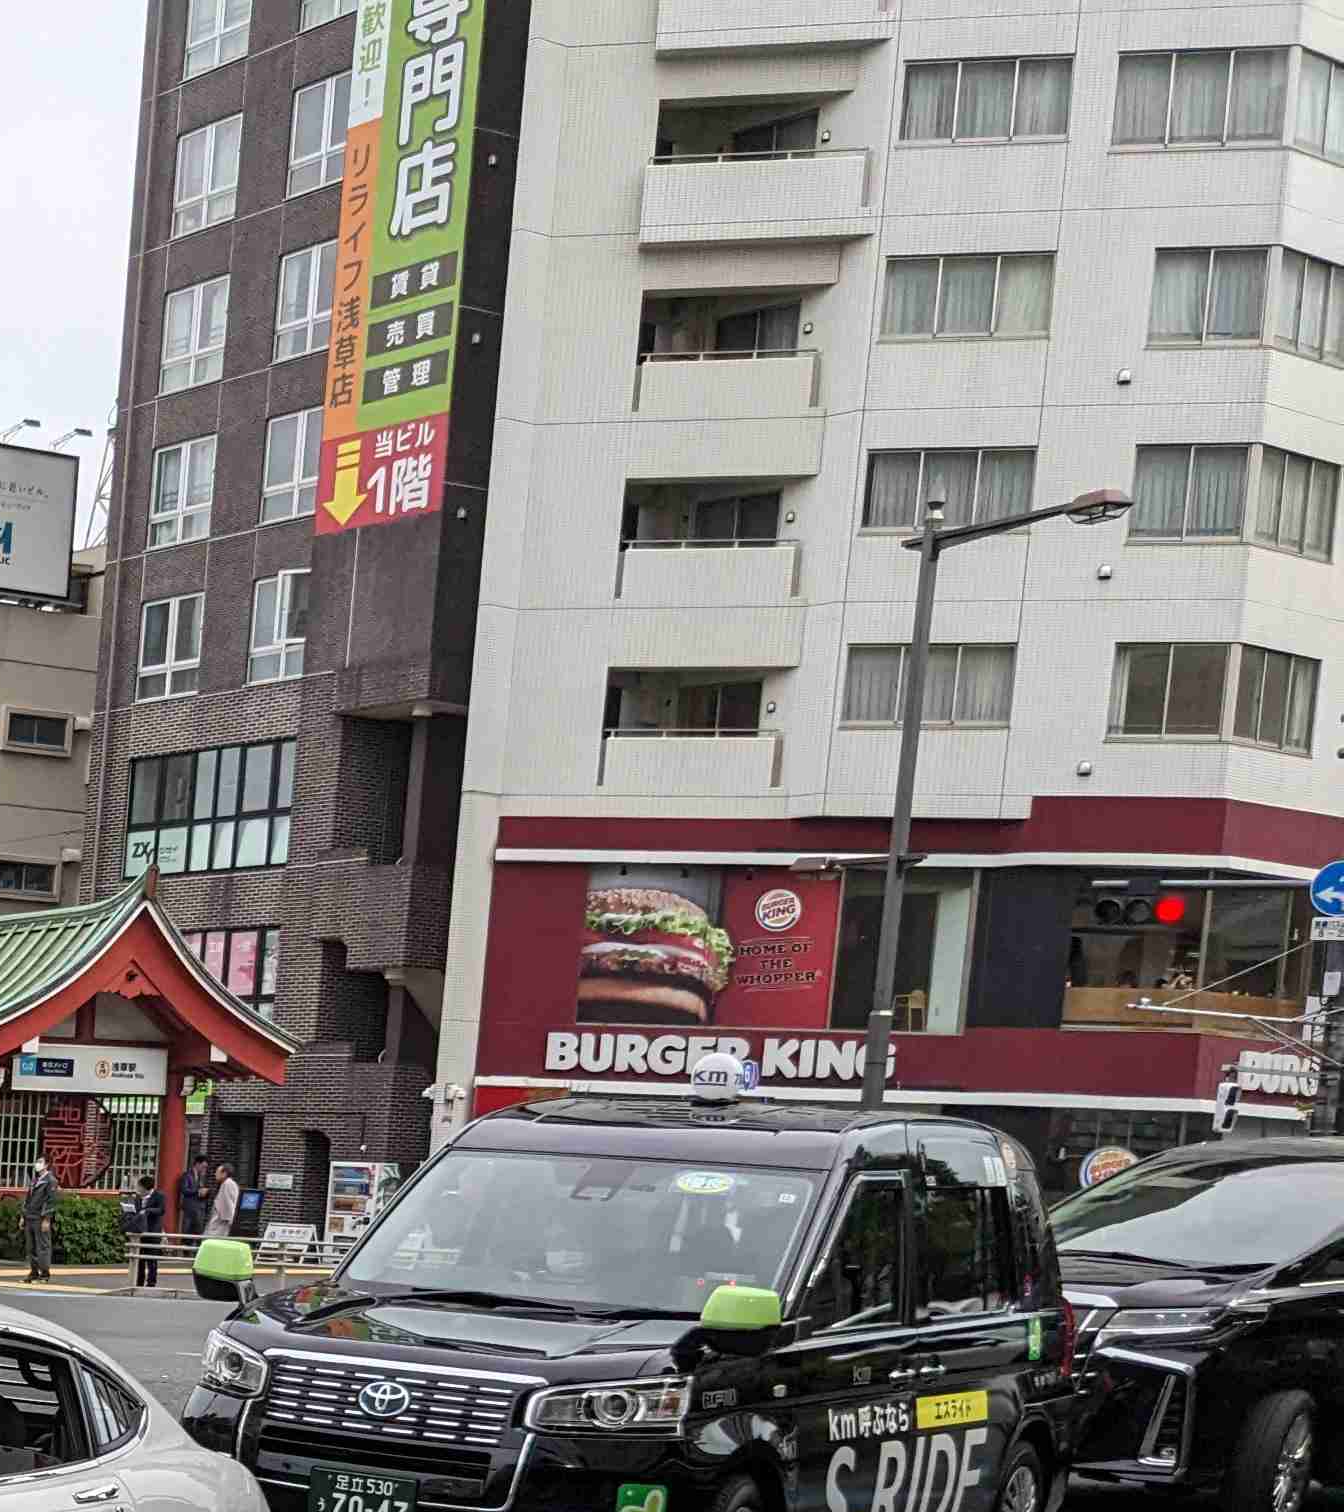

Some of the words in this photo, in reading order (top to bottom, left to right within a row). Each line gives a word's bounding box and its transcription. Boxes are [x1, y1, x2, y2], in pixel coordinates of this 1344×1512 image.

[329, 143, 371, 409] リライフ浅草店
[385, 309, 436, 348] 売買
[382, 359, 432, 396] 管理
[374, 420, 436, 459] 当ビル
[366, 452, 433, 516] 1階
[762, 904, 797, 921] KING
[739, 944, 785, 956] HOME
[791, 943, 809, 955] OF
[760, 959, 793, 969] THE
[736, 972, 817, 985] WHOPPER
[935, 1399, 972, 1420] エスライド
